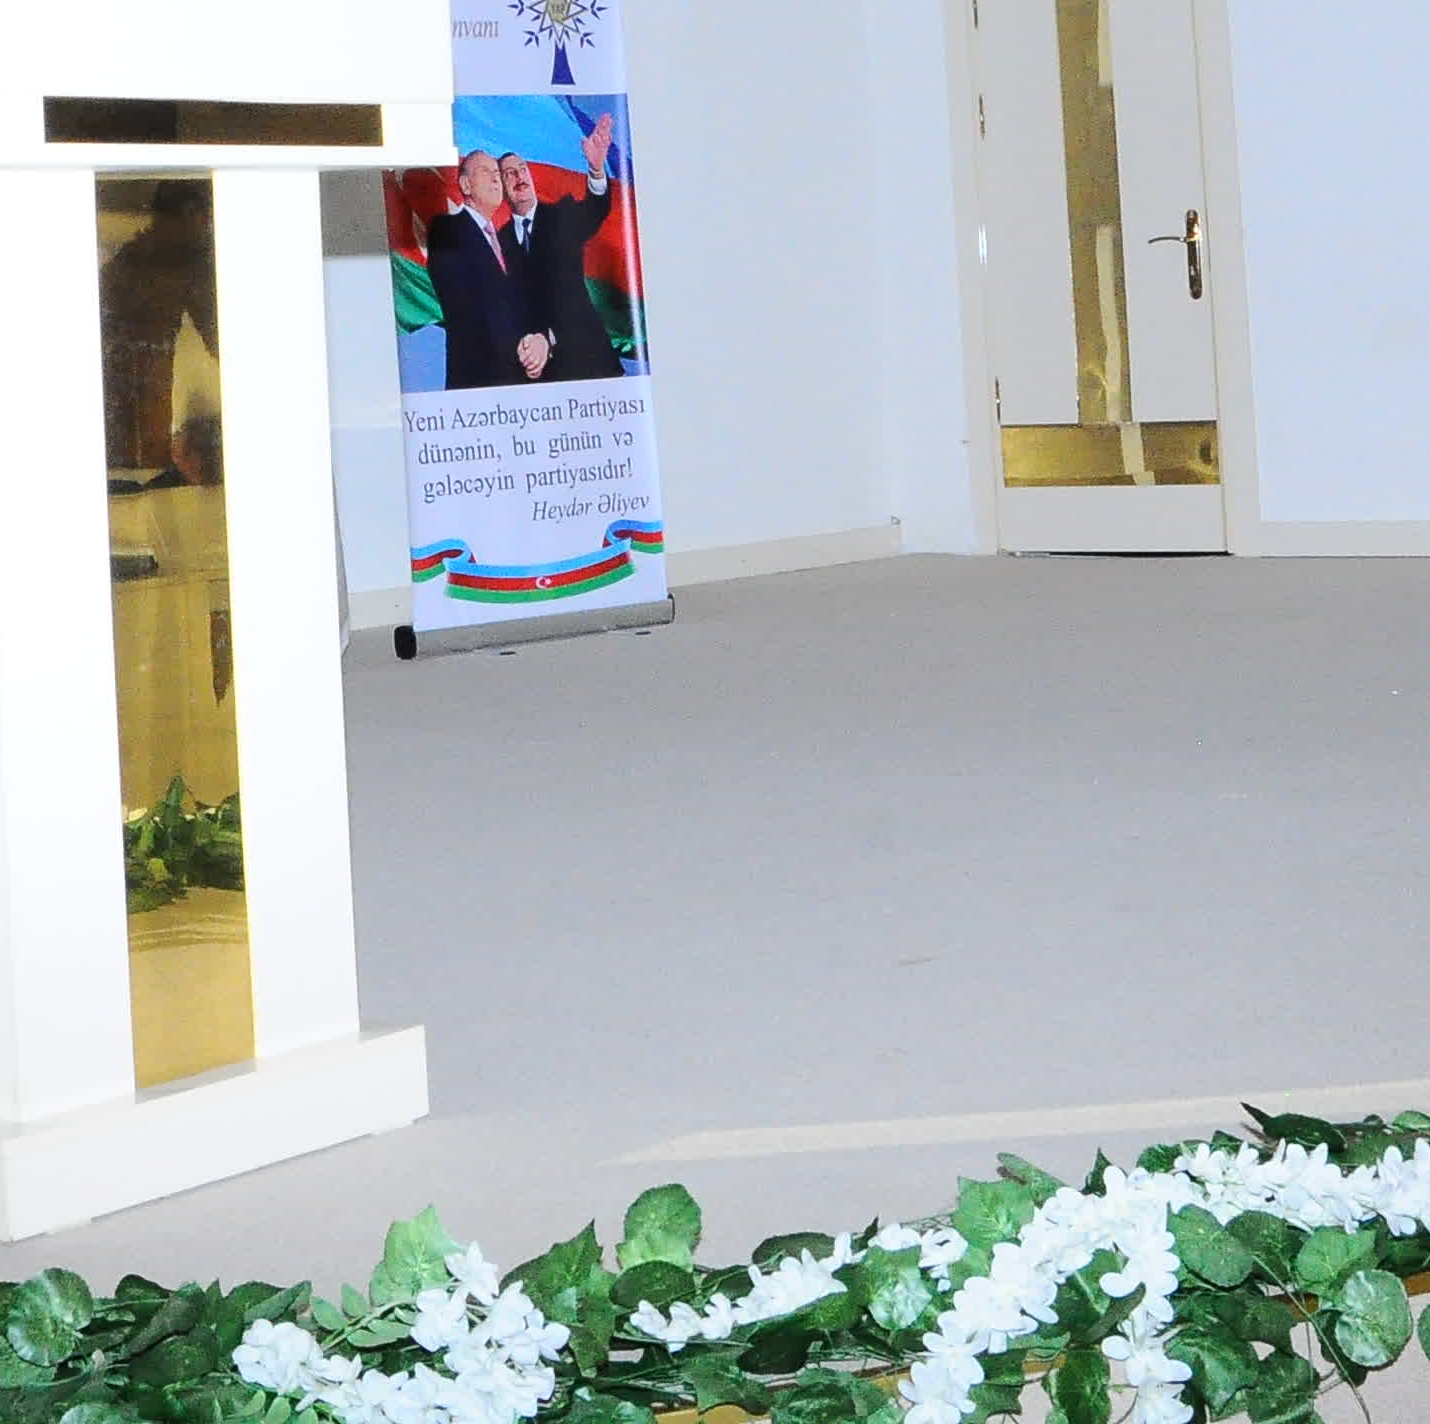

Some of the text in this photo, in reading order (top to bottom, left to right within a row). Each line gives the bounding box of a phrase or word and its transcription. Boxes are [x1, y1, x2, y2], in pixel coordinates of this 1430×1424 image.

[404, 395, 646, 434] Yeni Azərbaycan Partiyası
[418, 430, 634, 465] dünənin, bu günün və
[423, 457, 634, 504] gələcəyin partiyasıdır!
[531, 493, 650, 525] Heydər Əliyev
